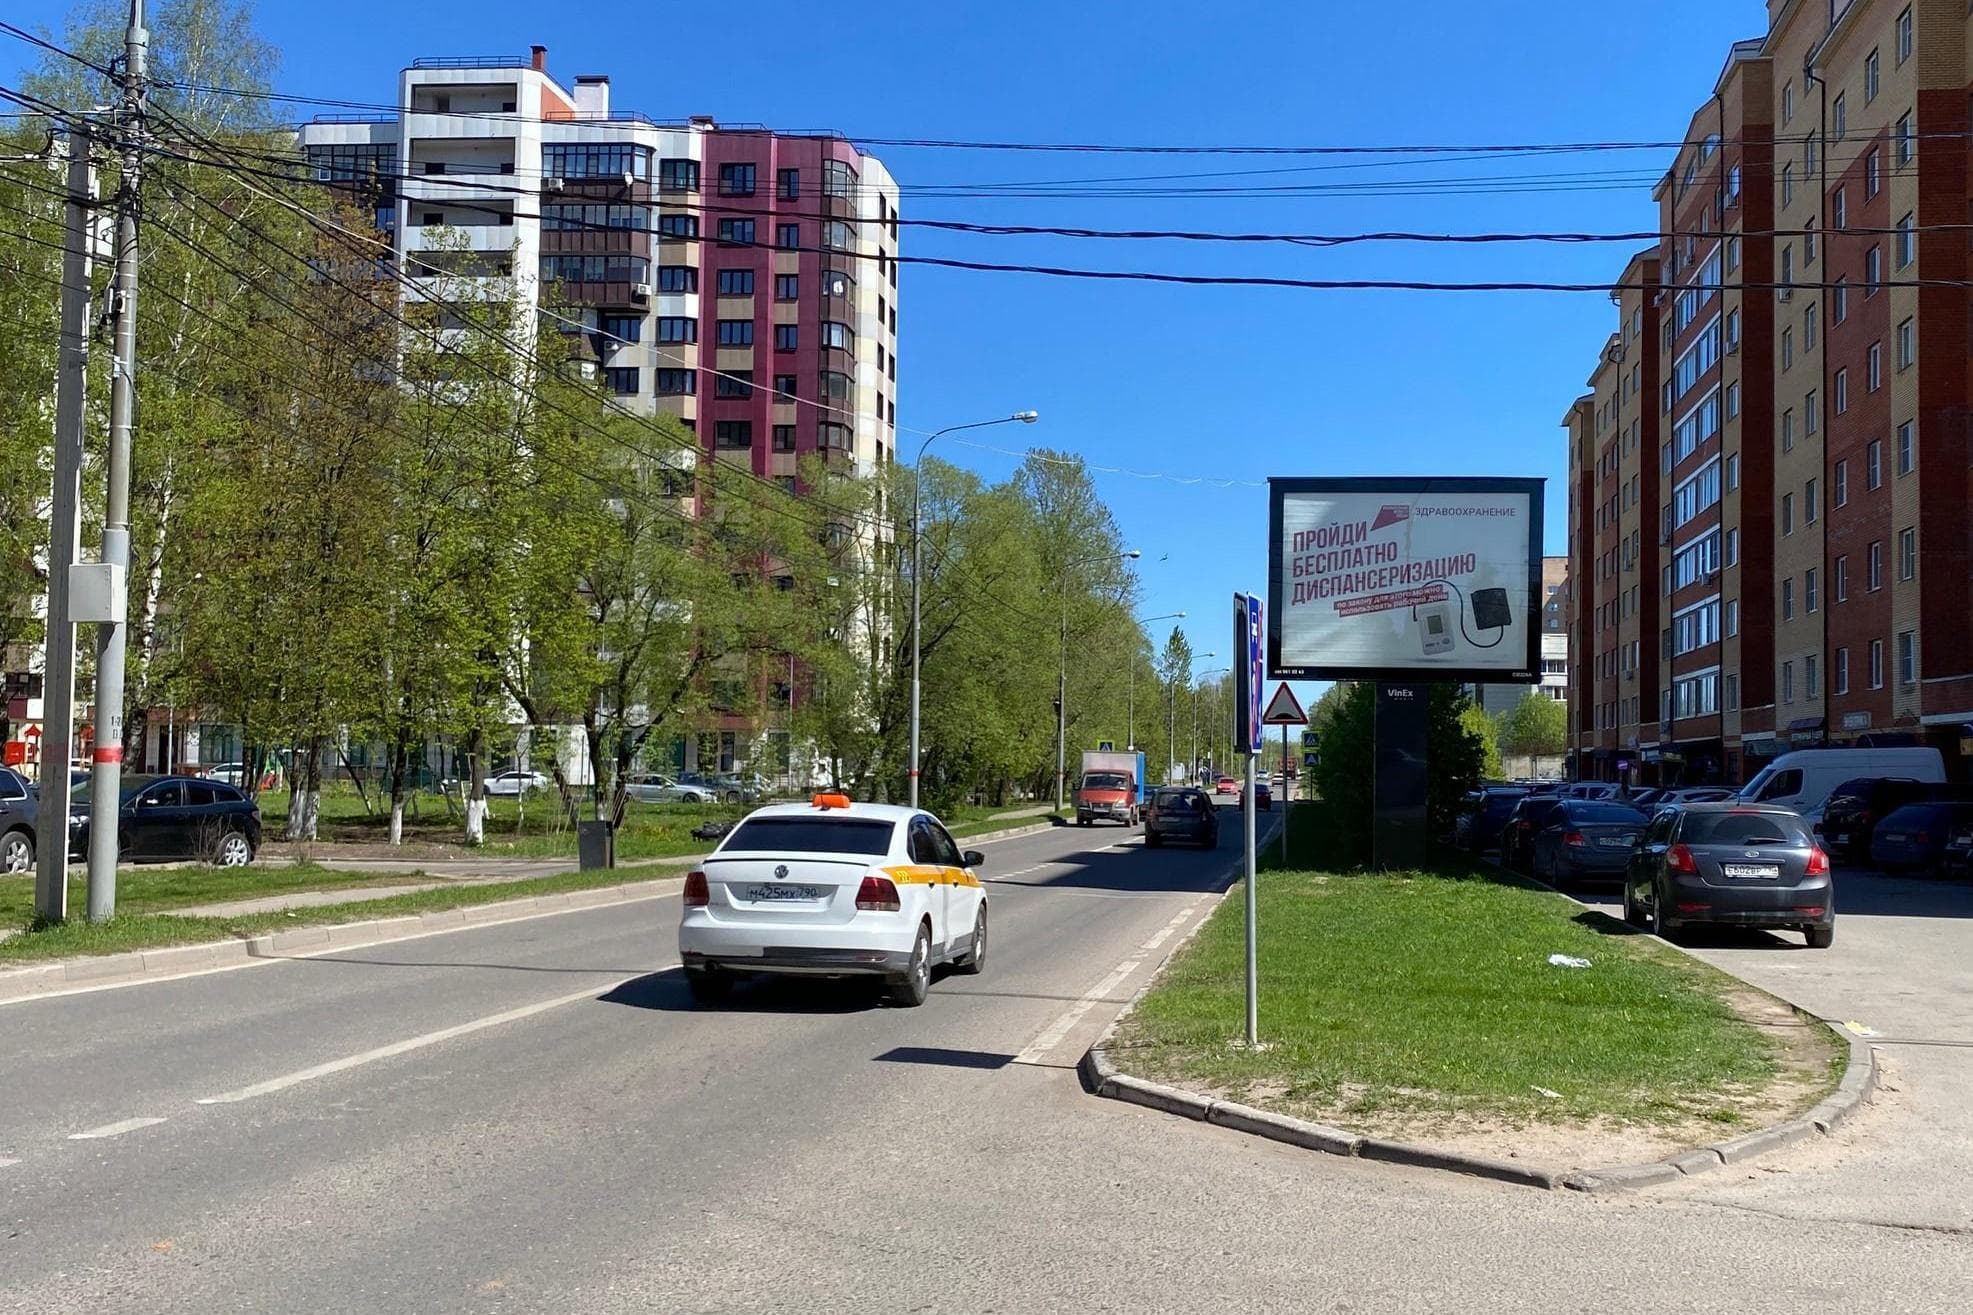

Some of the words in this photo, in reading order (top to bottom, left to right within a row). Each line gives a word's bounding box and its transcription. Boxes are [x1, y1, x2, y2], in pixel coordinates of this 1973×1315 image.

[1415, 507, 1517, 517] ЗДРАВООХРАНЕНИЕ
[1293, 520, 1367, 552] ПРОЙДИ
[1292, 541, 1398, 578] БЕСПЛАТНО
[1291, 553, 1476, 606] ДИСПАНСЕРИЗАЦИЮ
